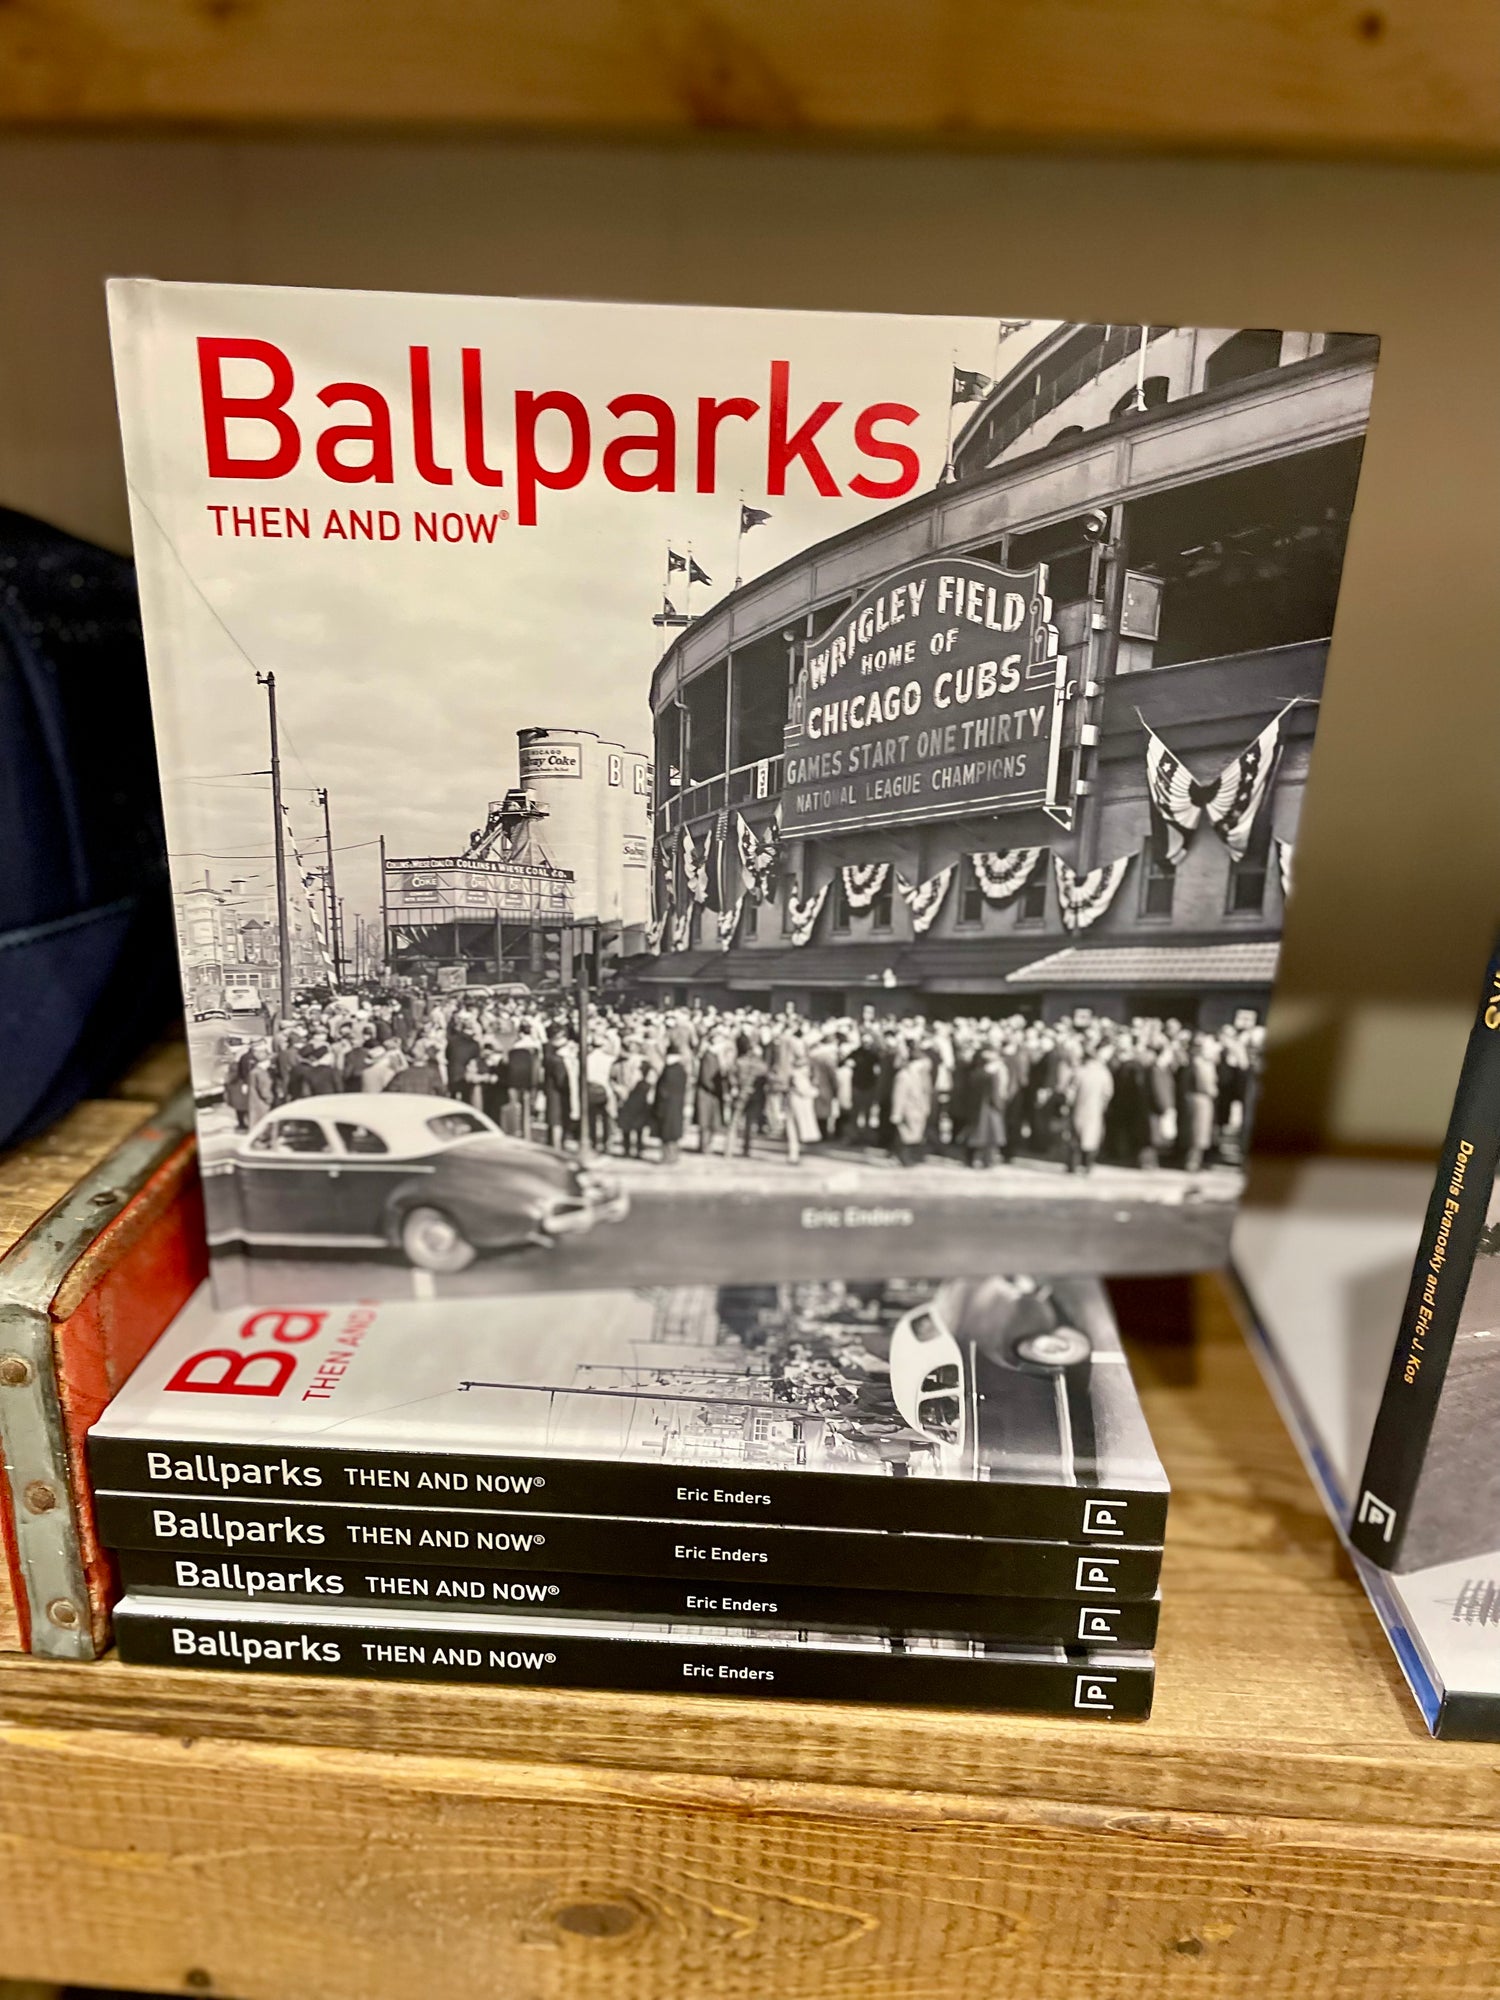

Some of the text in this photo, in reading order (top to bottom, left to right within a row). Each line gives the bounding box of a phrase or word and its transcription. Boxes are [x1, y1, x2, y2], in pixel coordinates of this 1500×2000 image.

[196, 337, 921, 526] Ballparks
[207, 505, 309, 538] THEN
[324, 509, 401, 541] AND
[808, 575, 1026, 690] WRIGLEY FIELD
[861, 628, 960, 676] HOME OF
[808, 654, 1022, 740] CHICAGO CUBS
[548, 755, 577, 766] Coke
[787, 750, 843, 785] GAMES
[850, 735, 910, 773] START
[917, 724, 957, 759] ONE
[961, 705, 1046, 750] THIRTY
[866, 773, 921, 802] LEAGUE
[932, 754, 1027, 791] CHAMPIONS
[456, 859, 490, 871] COLLINS
[498, 864, 525, 875] WIESE
[526, 866, 549, 877] COAL
[801, 1205, 914, 1229] Eric Enders
[1403, 1139, 1475, 1384] Dennis Evanosky and Eric J. Kos
[302, 1350, 356, 1402] THEN
[148, 1452, 323, 1490] Ballparks
[344, 1468, 409, 1488] THEN
[417, 1471, 468, 1491] AND
[676, 1487, 771, 1505] Eric Enders
[153, 1510, 325, 1547] Ballparks
[347, 1525, 411, 1545] THEN
[419, 1529, 469, 1549] AND
[674, 1545, 768, 1563] Eric Enders
[175, 1561, 344, 1596] Ballparks
[365, 1576, 429, 1596] THEN
[436, 1580, 485, 1599] AND
[686, 1595, 778, 1613] Eric Enders
[172, 1628, 341, 1664] Ballparks
[362, 1644, 425, 1663] THEN
[432, 1648, 481, 1667] AND
[683, 1663, 774, 1681] Eric Enders
